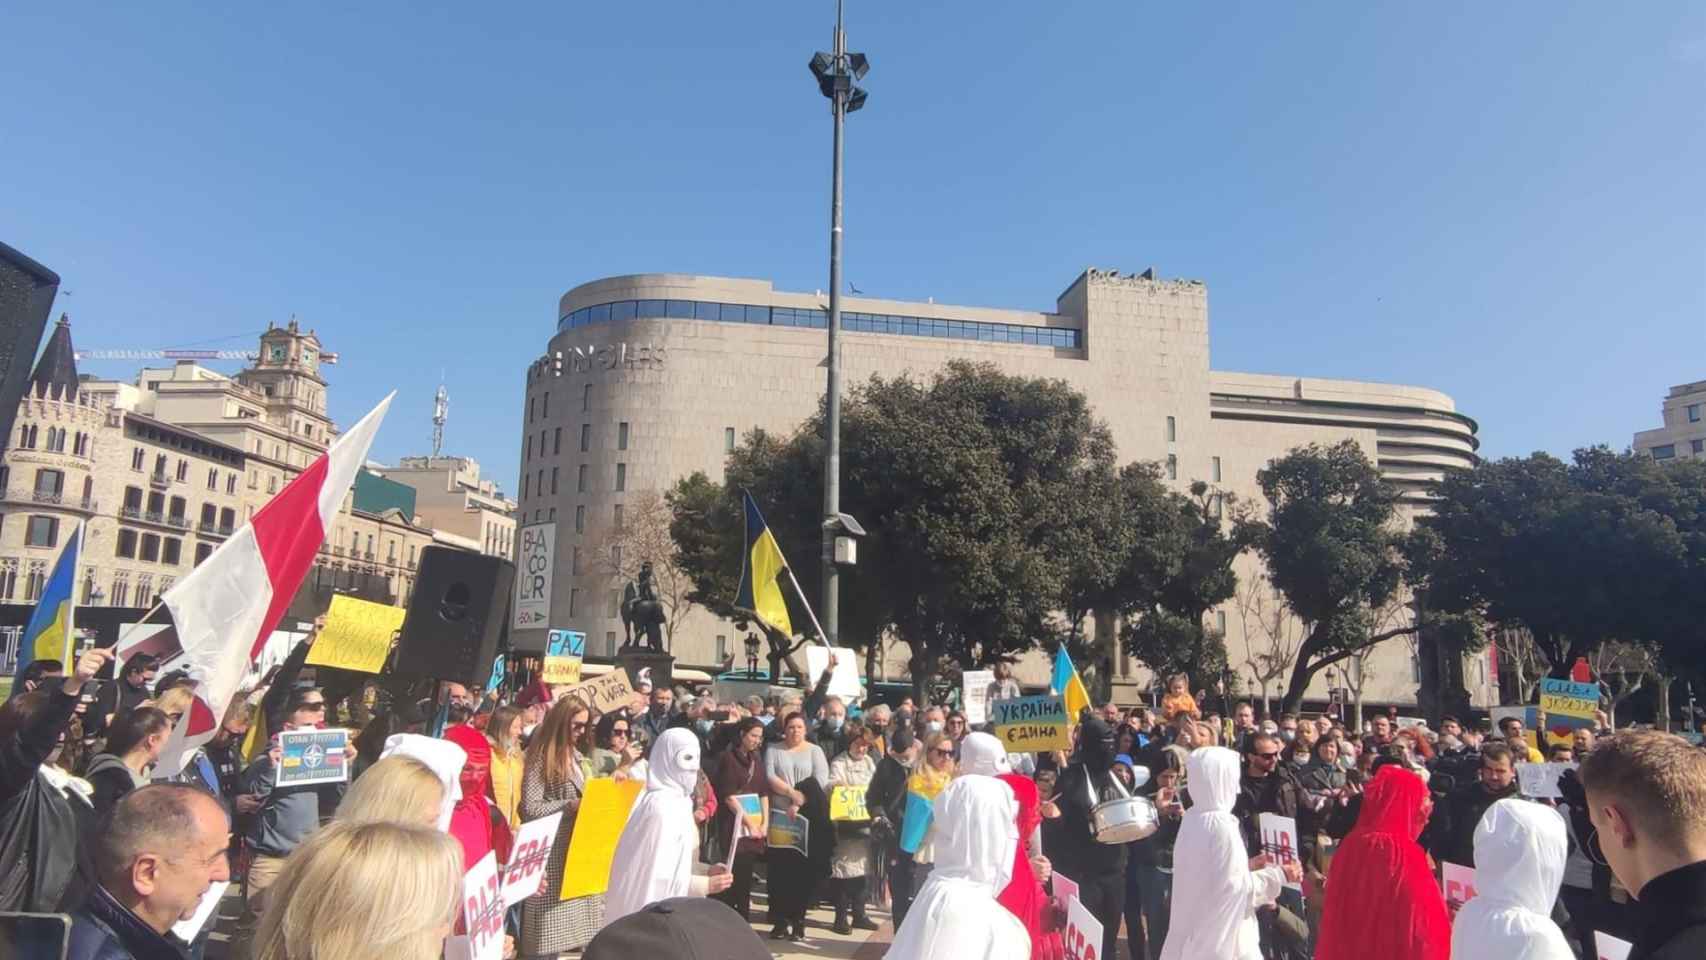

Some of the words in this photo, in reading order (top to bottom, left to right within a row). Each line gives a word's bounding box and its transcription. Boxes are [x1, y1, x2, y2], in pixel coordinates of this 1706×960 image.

[547, 632, 584, 656] PAZ
[600, 683, 629, 703] WAR
[1000, 700, 1064, 723] УКРАЇНА
[1007, 726, 1057, 743] ЄДИНА
[840, 788, 866, 804] STA
[847, 806, 866, 818] WIT
